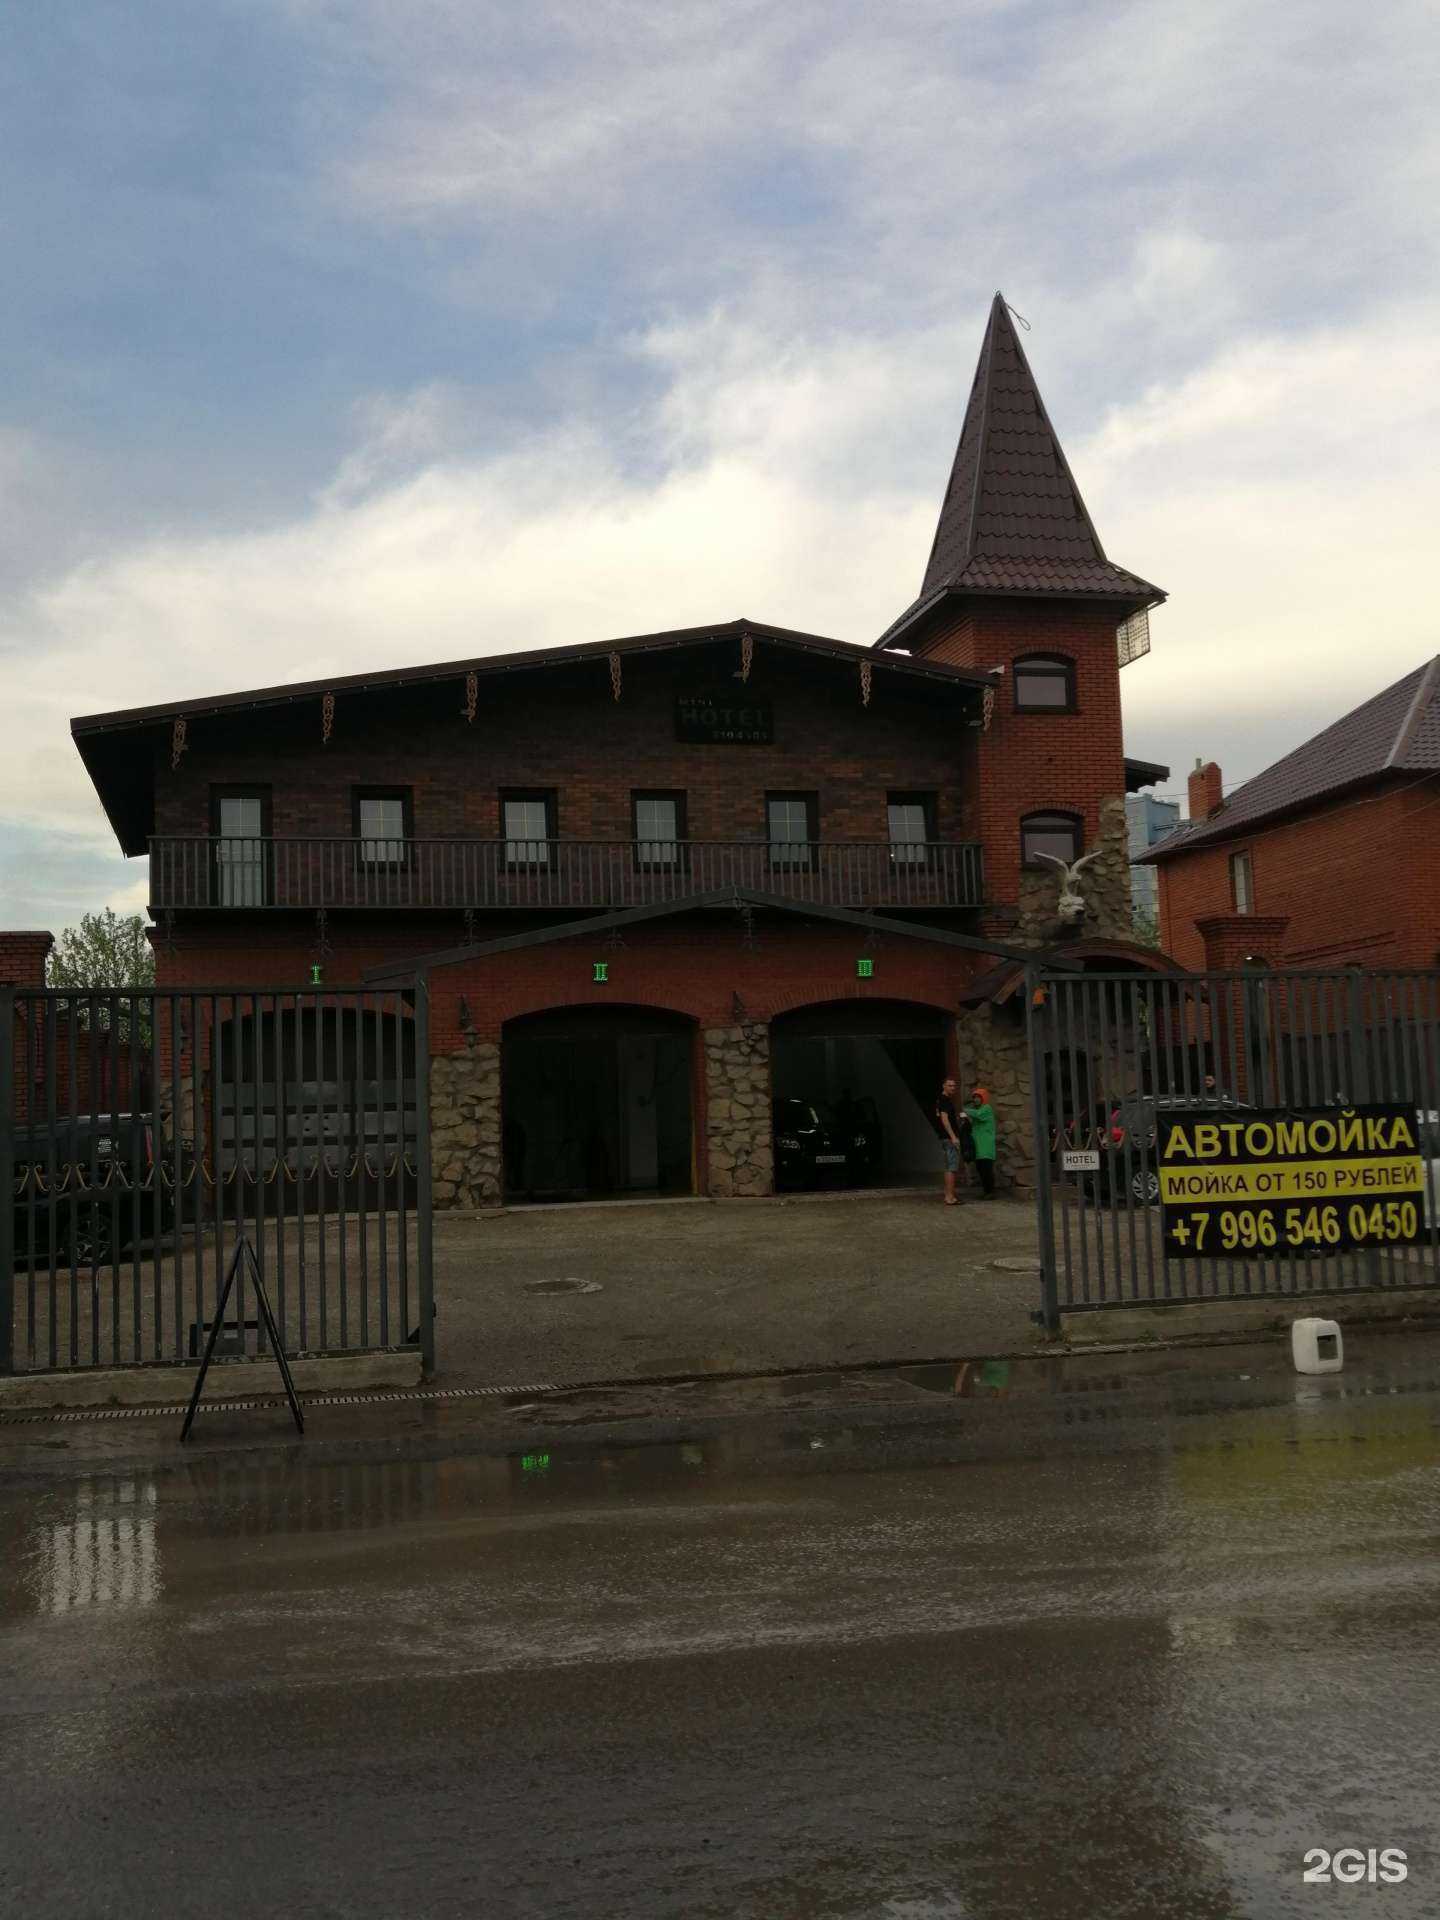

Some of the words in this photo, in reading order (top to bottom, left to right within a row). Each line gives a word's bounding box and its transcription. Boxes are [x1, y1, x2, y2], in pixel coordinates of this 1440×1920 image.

[680, 708, 764, 727] HOTEL
[1163, 1110, 1415, 1158] АВТОМОЙКА
[1065, 1155, 1096, 1164] HOTEL
[1167, 1171, 1248, 1195] МОЙКА
[1256, 1173, 1285, 1192] ОТ
[1292, 1171, 1327, 1190] 150
[1334, 1162, 1417, 1188] РУБЛЕЙ
[1172, 1212, 1210, 1250] +7
[1219, 1209, 1277, 1249] 996
[1286, 1205, 1341, 1245] 546
[1348, 1201, 1417, 1241] 0450
